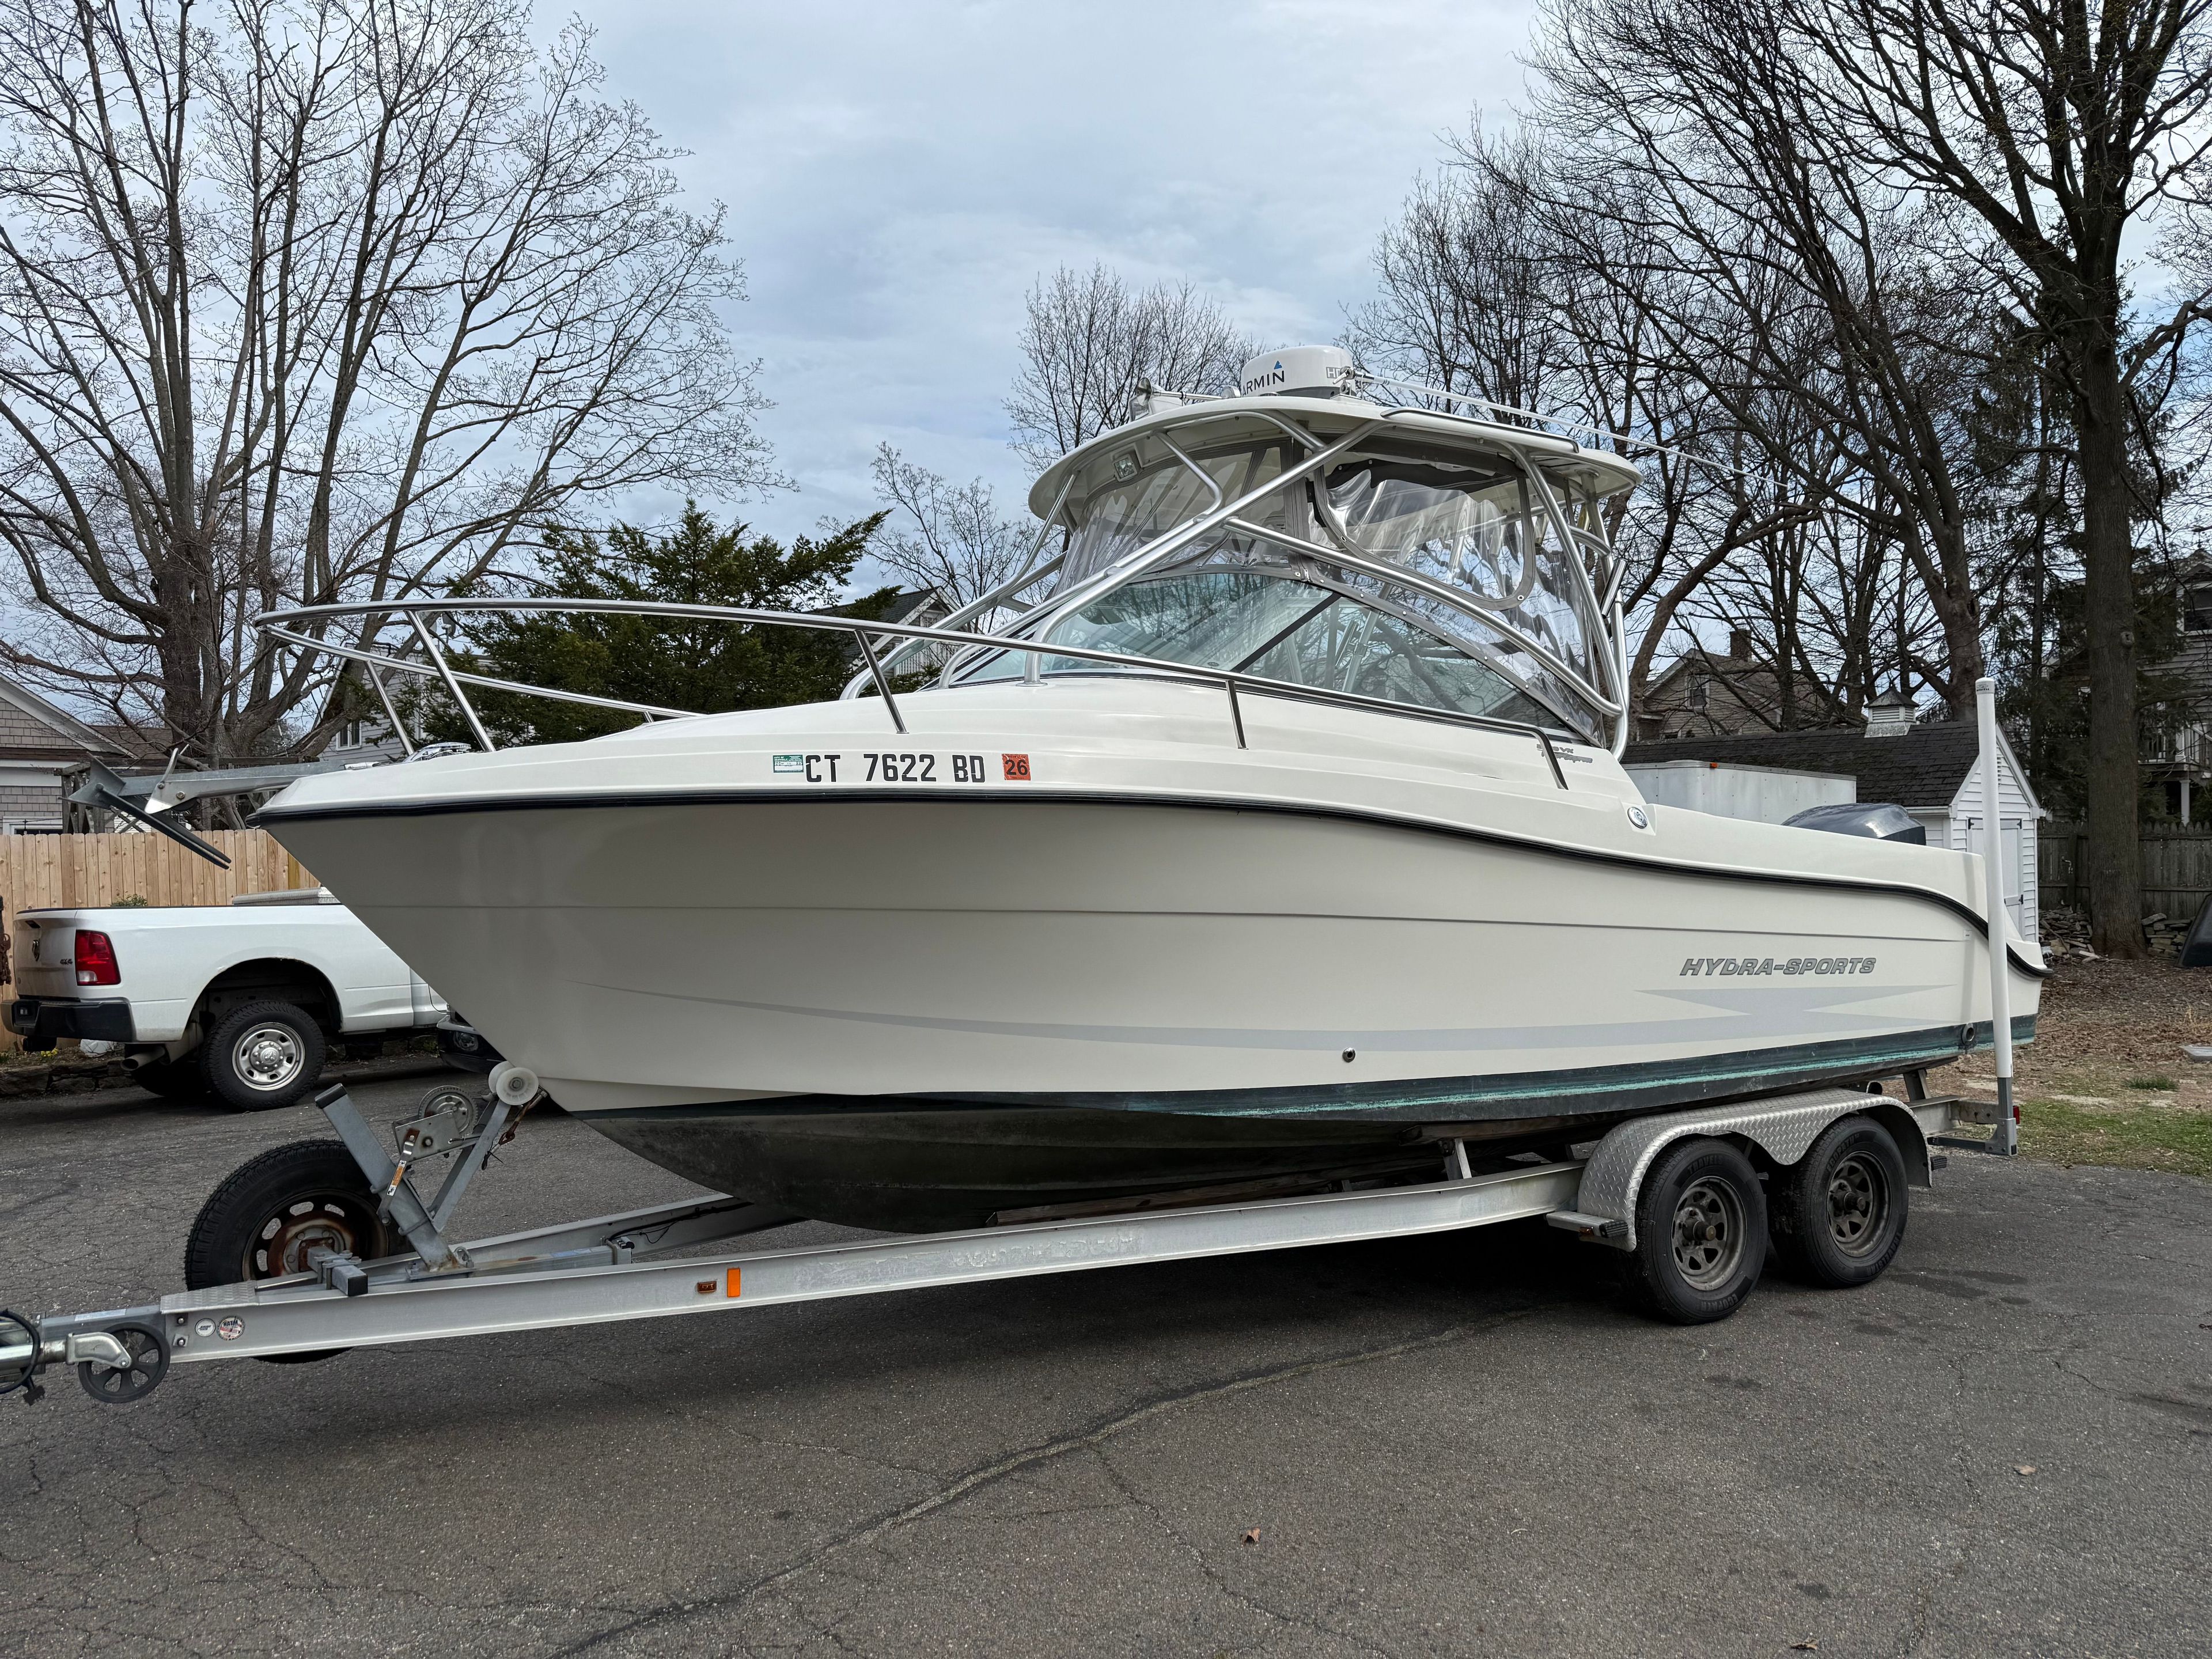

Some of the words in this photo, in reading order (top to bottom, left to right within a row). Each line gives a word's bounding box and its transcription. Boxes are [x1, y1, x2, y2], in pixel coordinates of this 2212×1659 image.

[1242, 370, 1285, 396] ARMIN
[806, 755, 840, 782] CT
[863, 753, 937, 782] 7622
[952, 755, 986, 782] BD
[1005, 759, 1028, 775] 26
[1679, 957, 1877, 976] HYDRA-SPORTS
